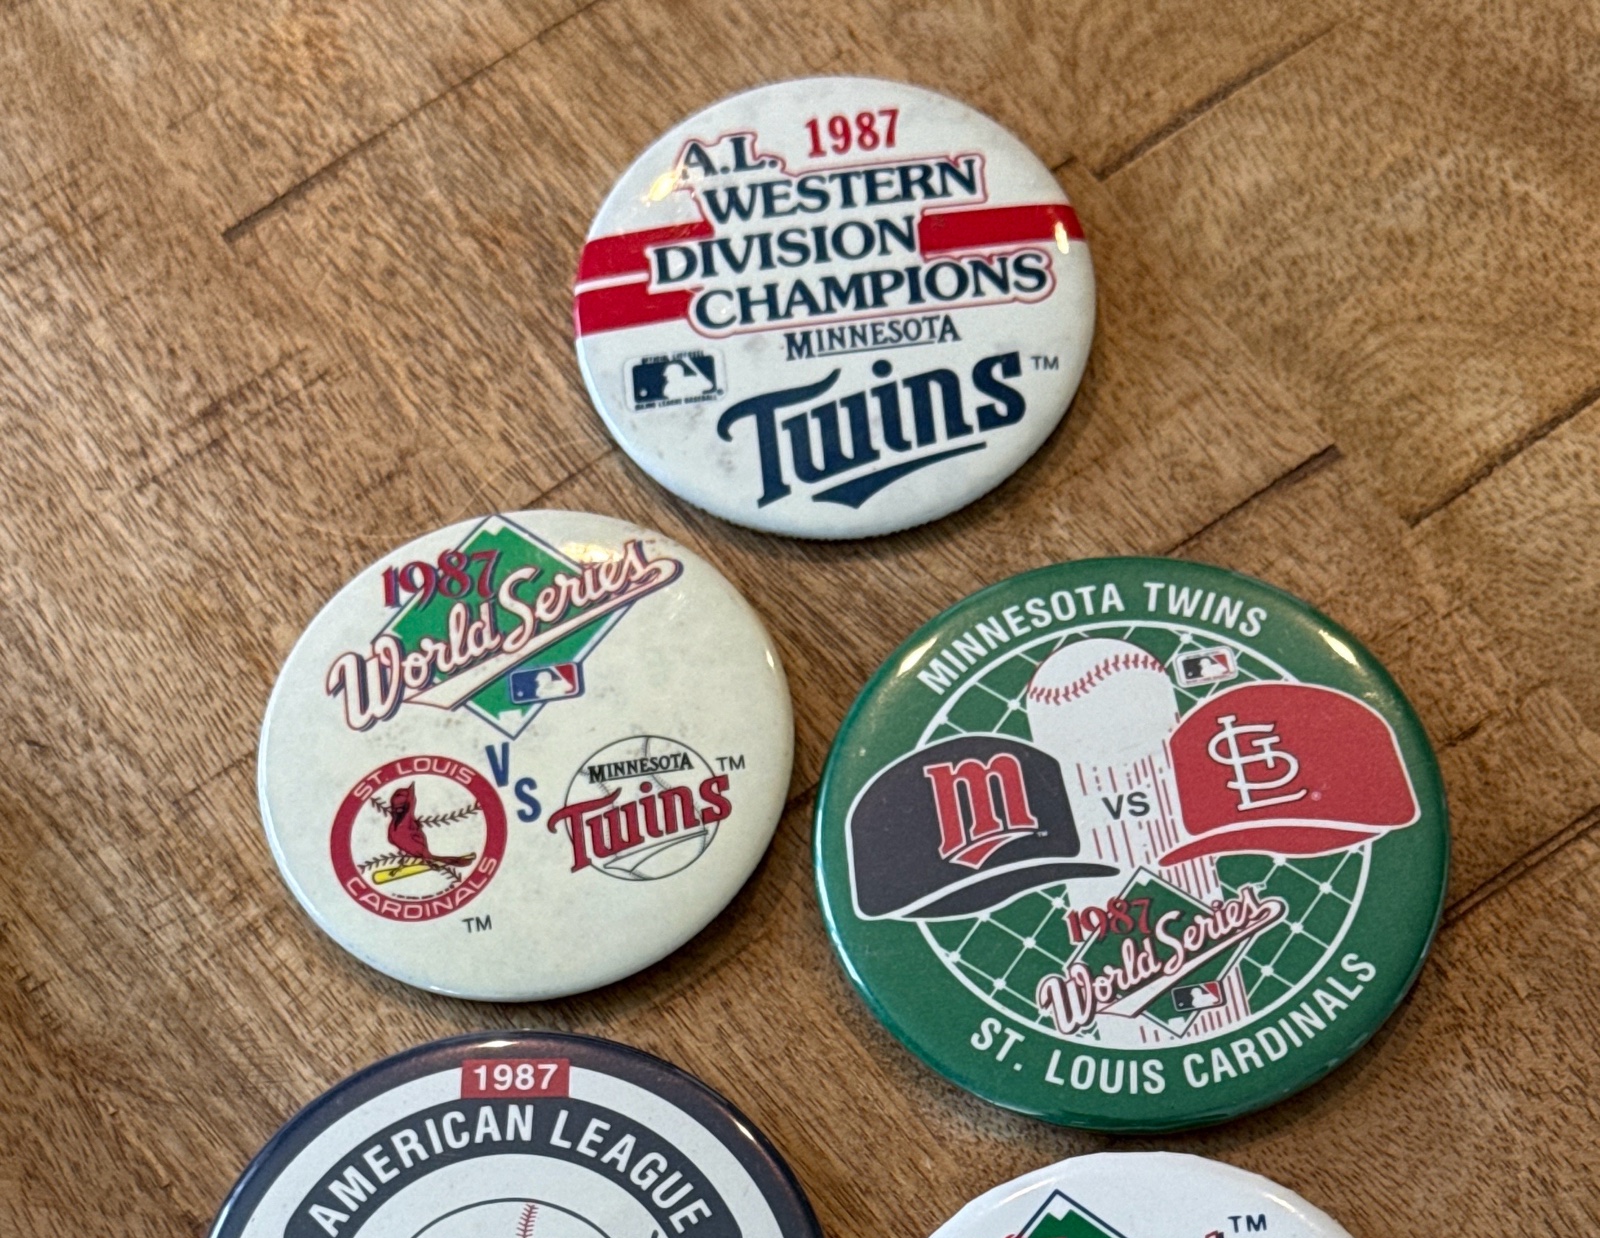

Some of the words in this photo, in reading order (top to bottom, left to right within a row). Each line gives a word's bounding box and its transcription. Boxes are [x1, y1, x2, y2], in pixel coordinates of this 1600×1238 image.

[681, 135, 779, 180] A.L.
[805, 108, 901, 158] 1987
[703, 157, 979, 224] WESTERN
[652, 215, 917, 286] DIVISION
[694, 252, 1048, 330] CHAMPIONS
[784, 314, 962, 361] MINNESOTA
[716, 351, 1027, 509] Twins
[1031, 355, 1060, 371] TM
[381, 549, 501, 608] 1987
[326, 602, 504, 731] World
[499, 540, 684, 653] Series
[917, 583, 1125, 695] MINNESOTA
[1144, 582, 1268, 637] TWINS
[354, 770, 391, 801] ST.
[397, 757, 476, 785] LOUIS
[588, 751, 694, 784] MINNESOTA
[547, 775, 733, 873] Twins
[716, 754, 746, 772] TM
[1103, 792, 1151, 820] VS
[346, 855, 498, 920] CARDINALS
[463, 915, 493, 933] TM
[1067, 896, 1152, 942] 1987
[1037, 937, 1162, 1035] World
[1154, 886, 1286, 976] Series
[970, 1017, 1023, 1071] ST.
[1045, 1049, 1166, 1094] LOUIS
[1183, 952, 1377, 1088] CARDINALS
[473, 1064, 558, 1090] 1987
[308, 1105, 534, 1237] AMERICAN
[551, 1110, 713, 1236] LEAGUE
[1228, 1214, 1267, 1232] TM
